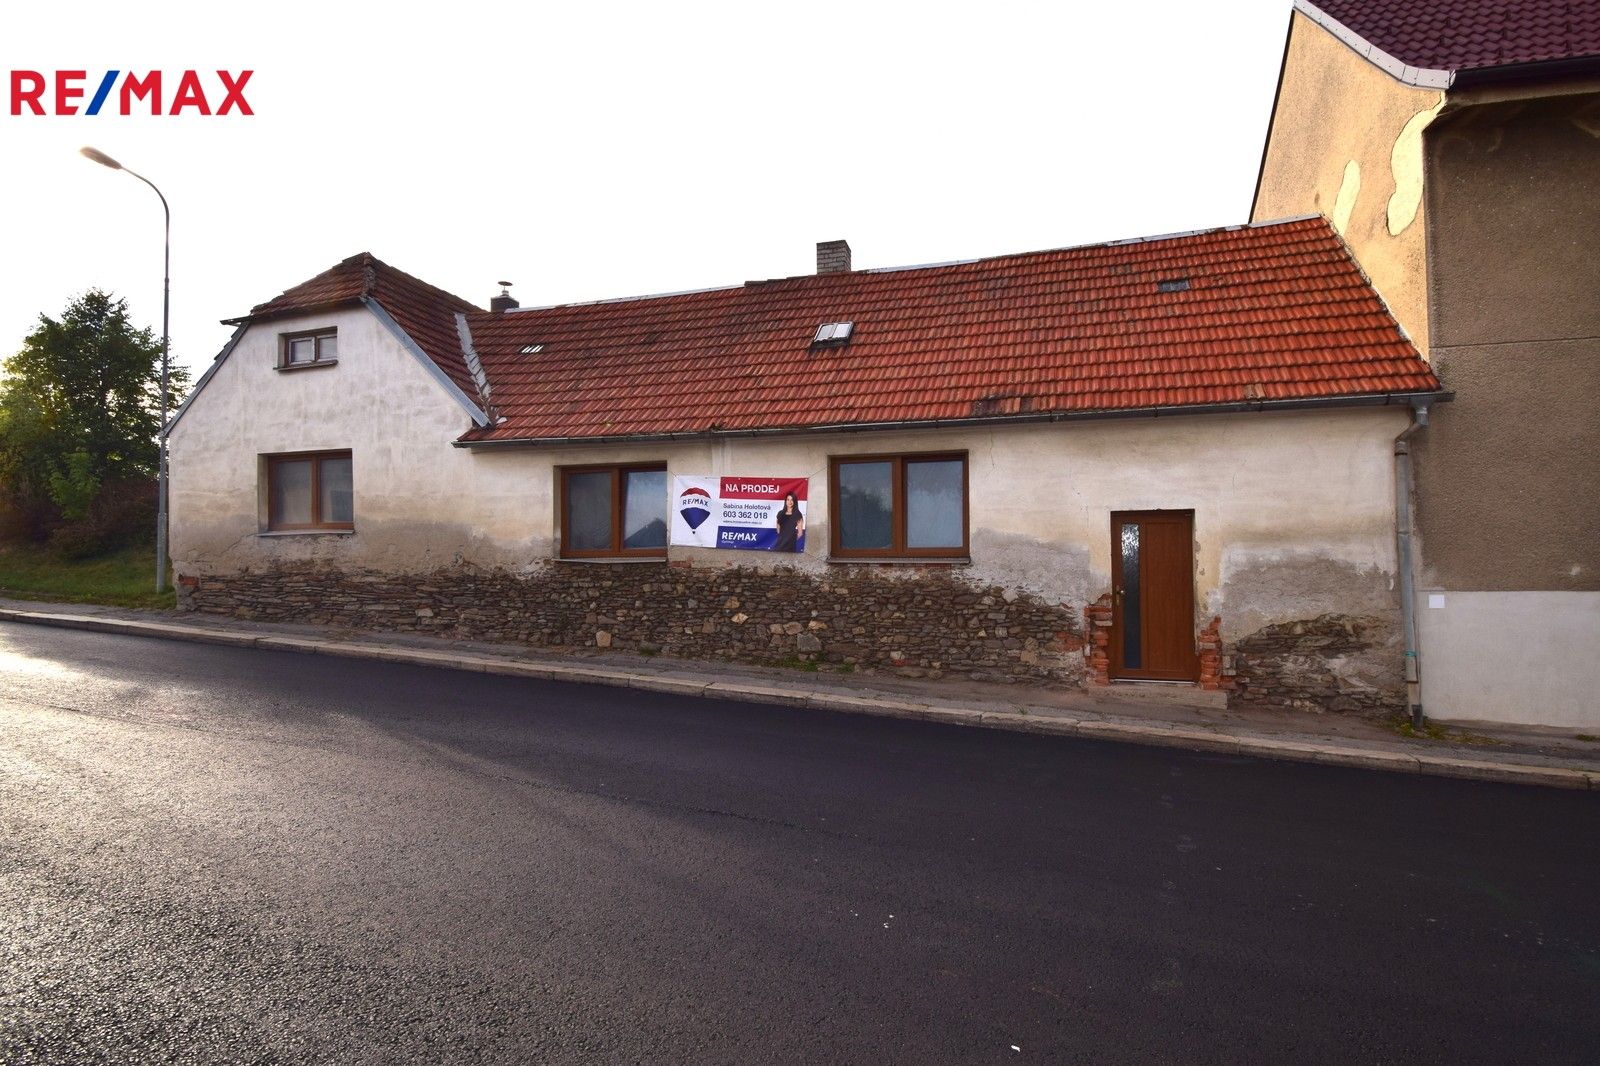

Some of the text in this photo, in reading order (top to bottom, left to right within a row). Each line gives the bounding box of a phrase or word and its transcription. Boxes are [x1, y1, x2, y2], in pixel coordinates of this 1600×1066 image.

[725, 483, 780, 494] NA PRODEJ
[682, 498, 709, 507] RE/MAX
[722, 510, 768, 520] 603 362 018
[721, 531, 758, 541] RE/MAX
